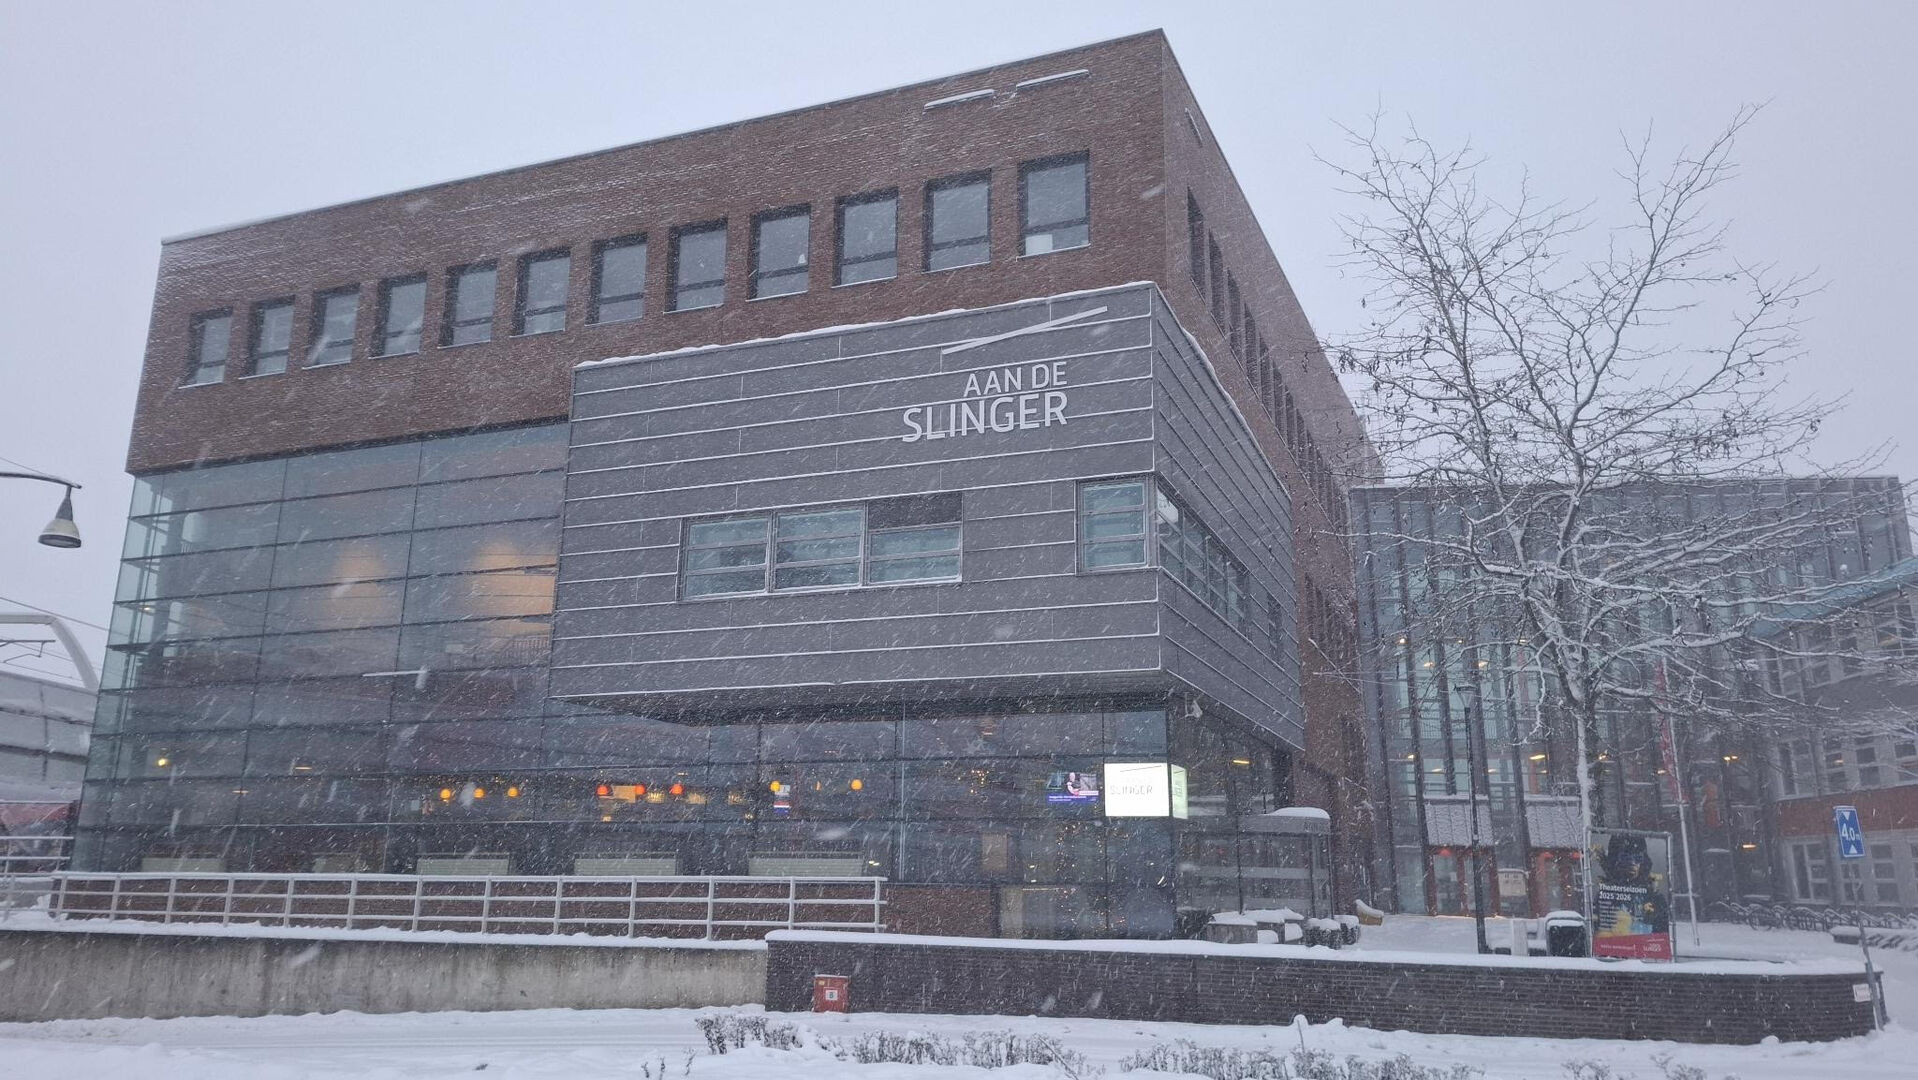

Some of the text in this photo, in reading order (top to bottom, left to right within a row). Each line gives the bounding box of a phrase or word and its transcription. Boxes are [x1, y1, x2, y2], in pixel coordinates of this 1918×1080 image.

[963, 361, 1068, 397] AAN DE
[902, 391, 1068, 442] SLINGER
[1598, 883, 1648, 894] Theaterseizoen
[1599, 891, 1632, 901] 2025 2026
